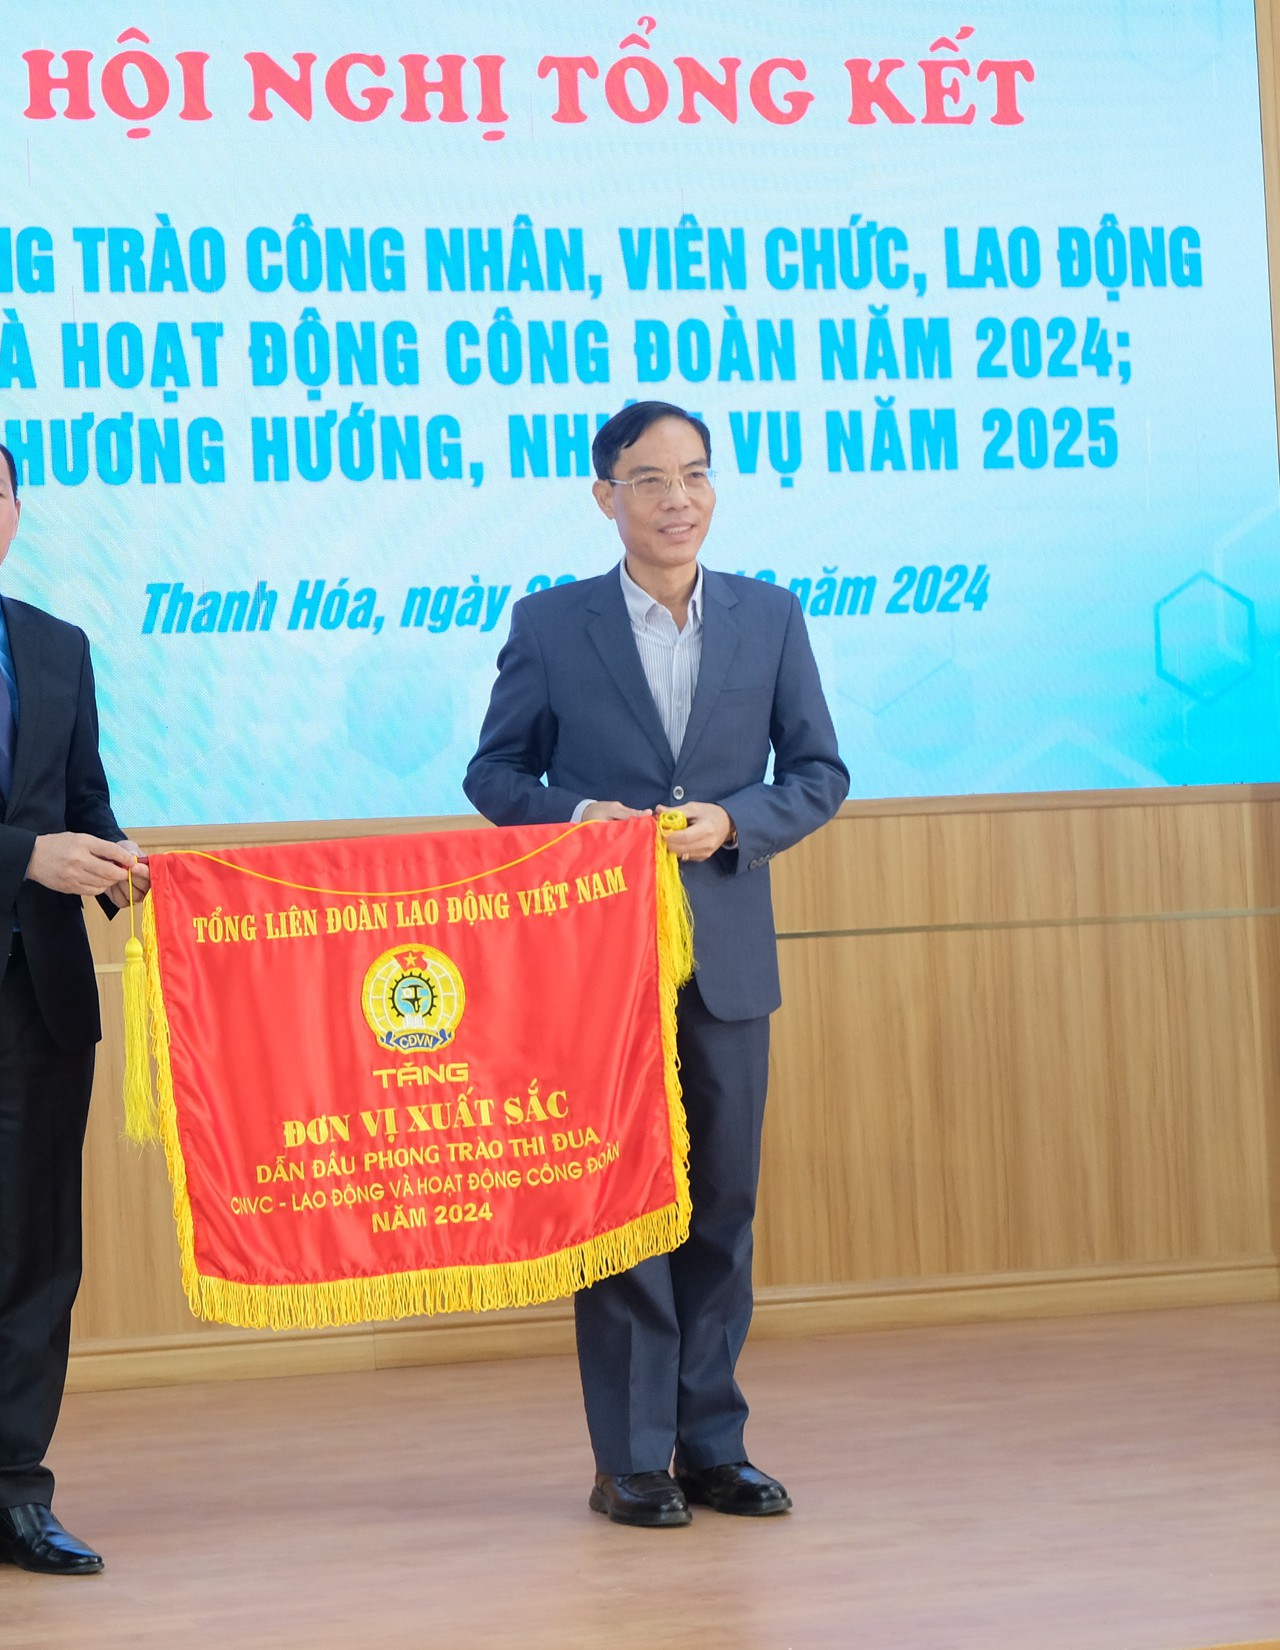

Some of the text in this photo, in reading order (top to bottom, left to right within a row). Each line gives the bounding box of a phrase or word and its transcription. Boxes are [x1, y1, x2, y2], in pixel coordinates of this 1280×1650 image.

[21, 15, 1036, 142] HỘI NGHỊ TỔNG KẾT
[73, 213, 226, 293] TRÀO
[246, 213, 406, 293] CÔNG
[425, 214, 602, 299] NHÂN,
[619, 214, 747, 291] VIÊN
[765, 214, 927, 297] CHỨC,
[944, 226, 1041, 289] LAO
[1057, 213, 1203, 302] ĐỘNG
[61, 321, 224, 403] HOẠT
[248, 307, 419, 401] ĐỘNG
[445, 307, 610, 386] CÔNG
[634, 305, 796, 383] ĐOÀN
[819, 304, 952, 381] NĂM
[976, 316, 1131, 385] 2024;
[251, 402, 484, 487] HƯỚNG,
[729, 411, 802, 488] VỤ
[826, 396, 959, 473] NĂM
[982, 407, 1119, 470] 2025
[142, 581, 278, 634] Thanh
[288, 578, 385, 634] Hóa,
[400, 575, 511, 634] ngày
[885, 564, 991, 614] 2024
[192, 865, 628, 944] TỔNG LIÊN ĐOÀN LAO ĐỘNG VIỆT NAM
[372, 1062, 470, 1089] TẶNG
[399, 1032, 434, 1049] CĐVN
[283, 1078, 569, 1148] ĐƠN VỊ XUẤT SẮC
[230, 1195, 273, 1215] CNVC
[291, 1190, 327, 1212] LAO
[330, 1182, 385, 1209] ĐỘNG
[389, 1173, 415, 1198] VÀ
[416, 1173, 463, 1195] HOẠT
[467, 1167, 522, 1194] ĐỘNG
[526, 1161, 583, 1187] CÔNG
[586, 1141, 620, 1175] ĐOÀN
[256, 1155, 305, 1184] DẪN
[363, 1144, 440, 1172] PHONG
[445, 1136, 504, 1162] TRÀO
[508, 1135, 546, 1158] THI
[551, 1126, 601, 1152] ĐUA
[371, 1202, 494, 1233] NĂM 2024
